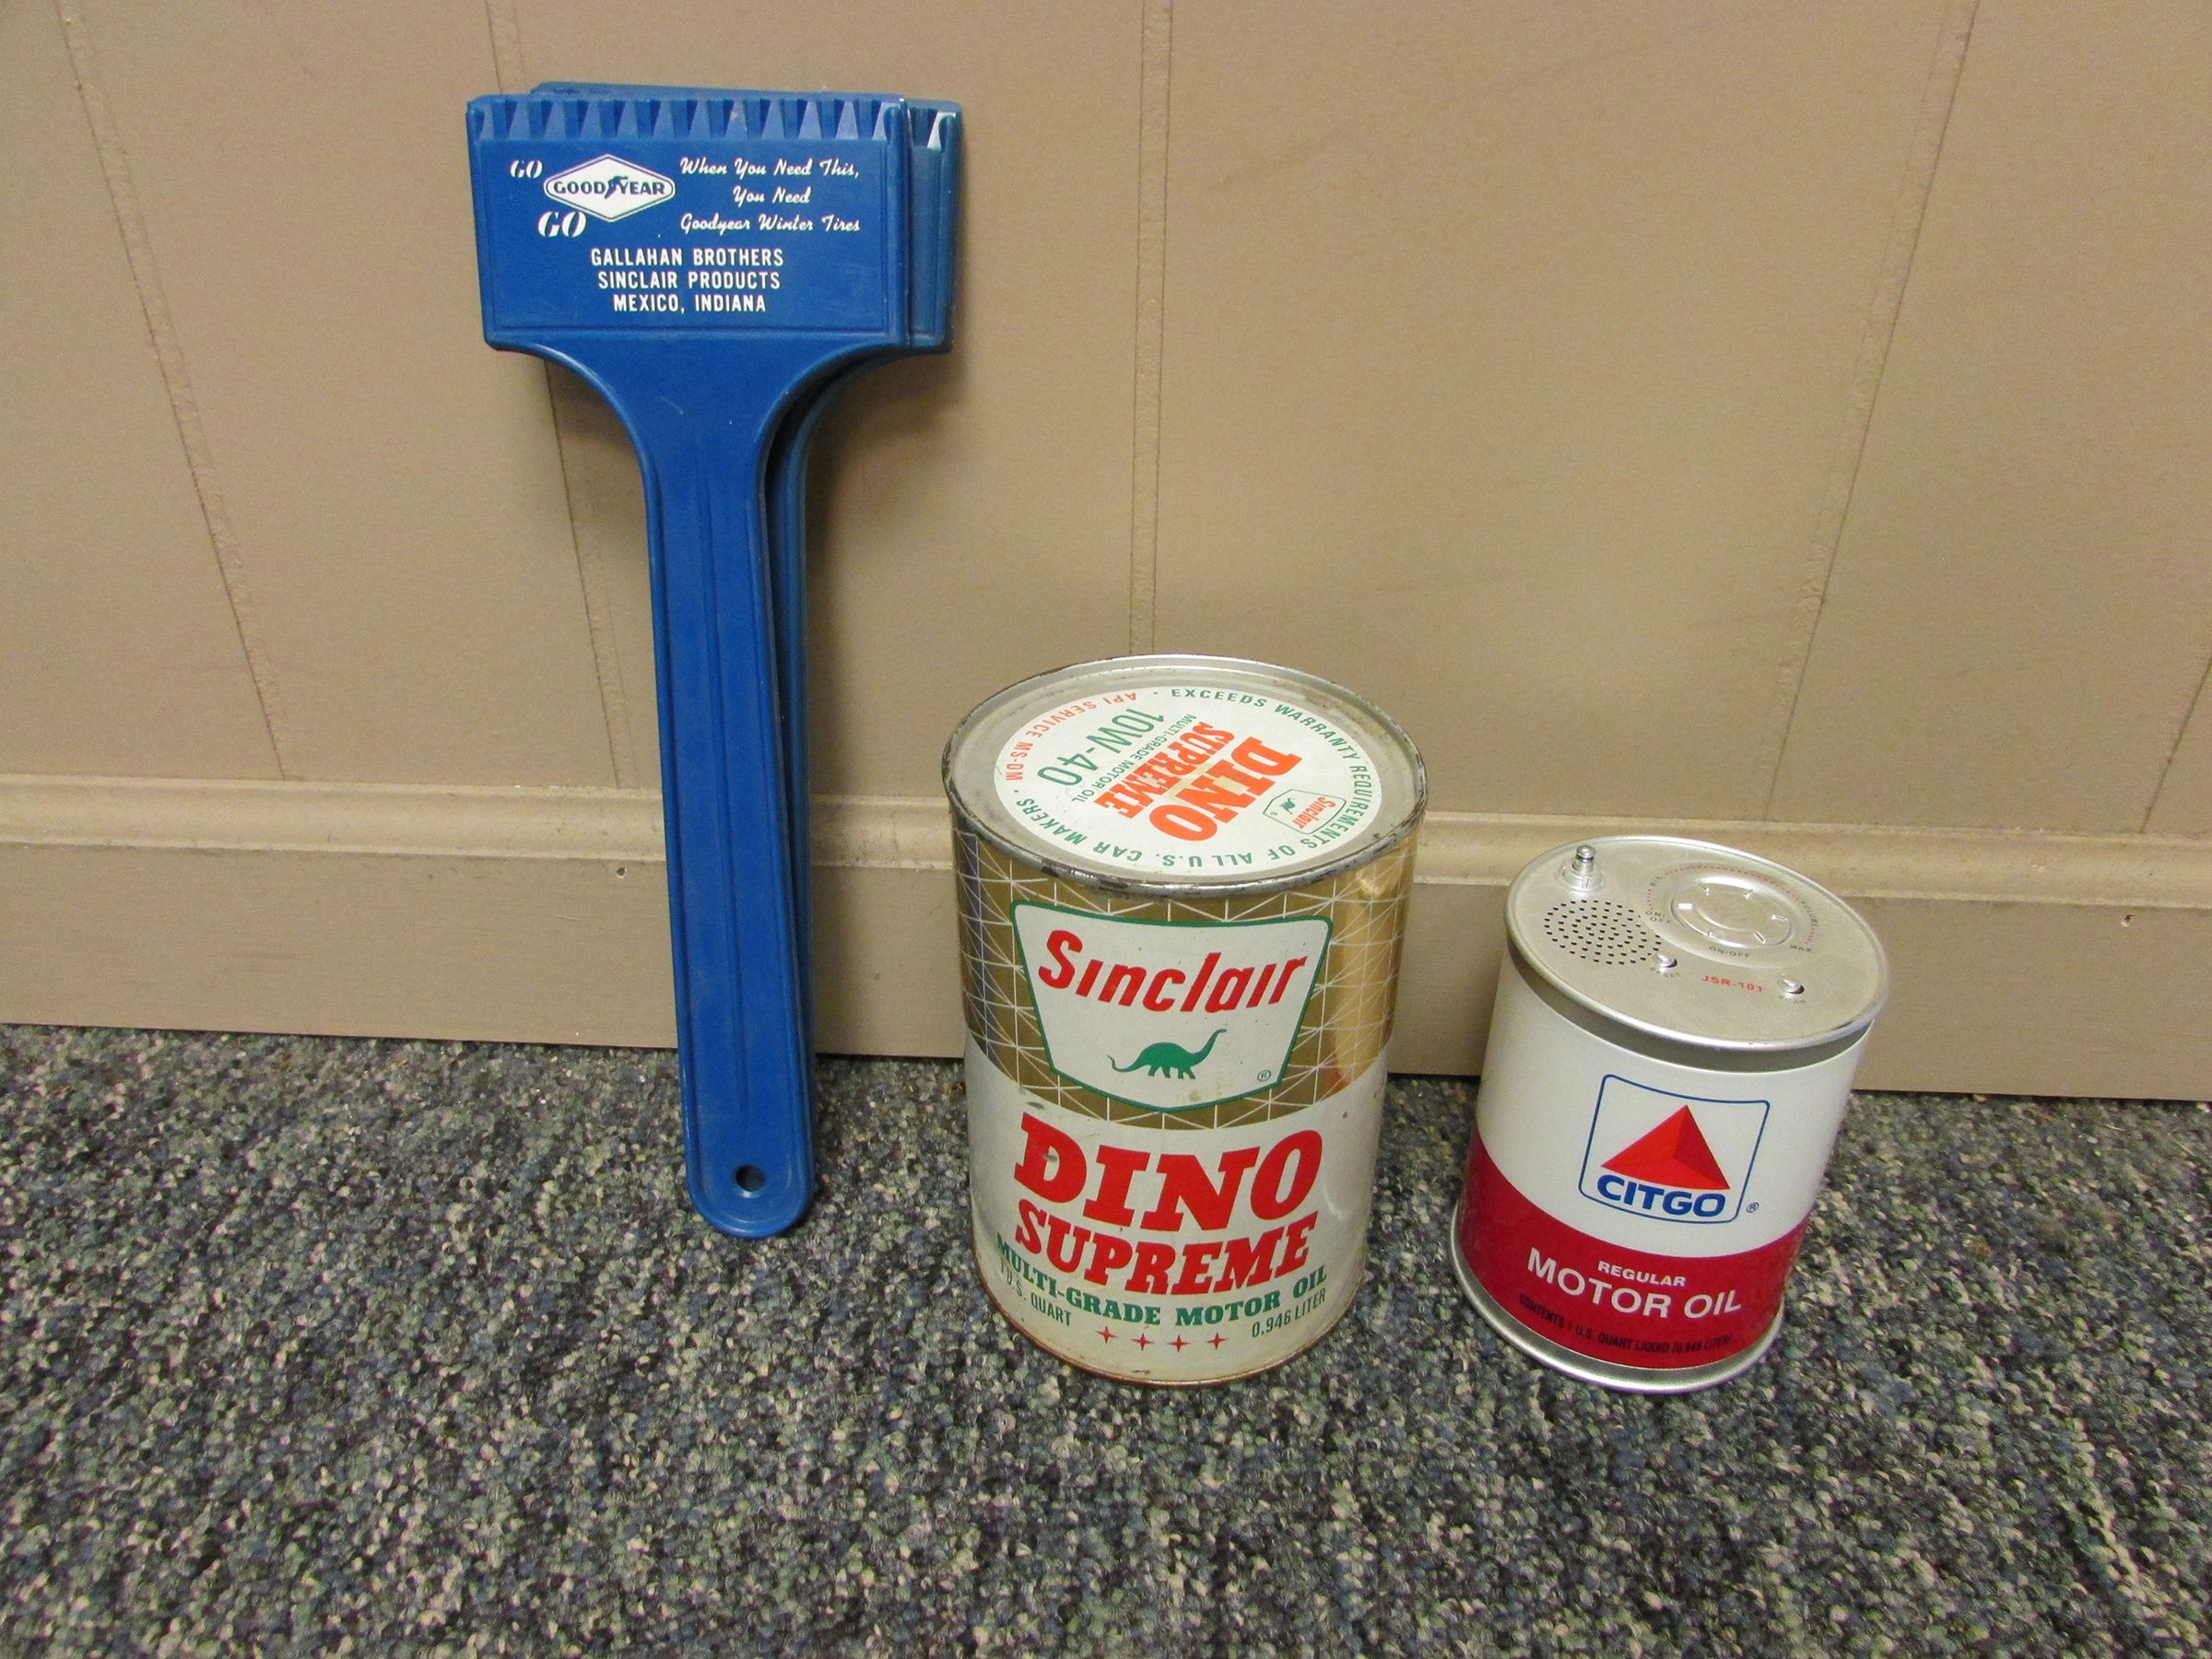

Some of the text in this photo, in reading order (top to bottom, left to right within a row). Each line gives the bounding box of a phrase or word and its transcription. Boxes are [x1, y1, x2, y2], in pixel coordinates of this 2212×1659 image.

[510, 159, 543, 179] GO
[679, 157, 859, 180] When You Need This,
[553, 175, 665, 199] GOODYEAR
[733, 185, 812, 208] You Need
[537, 211, 587, 239] GO
[680, 213, 860, 236] Goodyear Winter Tires
[591, 248, 783, 266] GALLAHAN BROTHERS
[598, 271, 781, 289] SINCLAIR PRODUCTS
[613, 294, 766, 314] MEXICO, INDIANA
[1102, 692, 1137, 705] API
[1025, 700, 1097, 738] SERVICE
[1037, 709, 1165, 785] 10W-40
[1072, 713, 1197, 803] MULTI-GRADE MOTOR OIL
[1016, 688, 1372, 867] EXCEEDS WARRANTY REQUIREMENTS OF ALL U.S. CAR MAKERS
[1094, 721, 1235, 818] SUPREME
[1149, 736, 1303, 841] DINO
[1291, 796, 1337, 830] Sinclair
[1709, 946, 1751, 959] ON/OFF
[1038, 929, 1308, 1013] Sinclair
[1700, 974, 1764, 993] JSR-101
[1014, 1112, 1323, 1231] DINO
[1596, 1173, 1726, 1218] CITGO
[1015, 1198, 1318, 1296] SUPREME
[996, 1231, 1327, 1326] MULTI-GRADE MOTOR OIL
[1526, 1247, 1741, 1319] MOTOR OIL
[1597, 1260, 1687, 1287] REGULAR
[1030, 1292, 1072, 1326] QUART
[1252, 1288, 1327, 1338] 0.946 LITER
[1519, 1294, 1564, 1328] CONTENTS
[1598, 1333, 1632, 1349] QUART
[1634, 1340, 1669, 1354] LIQUID
